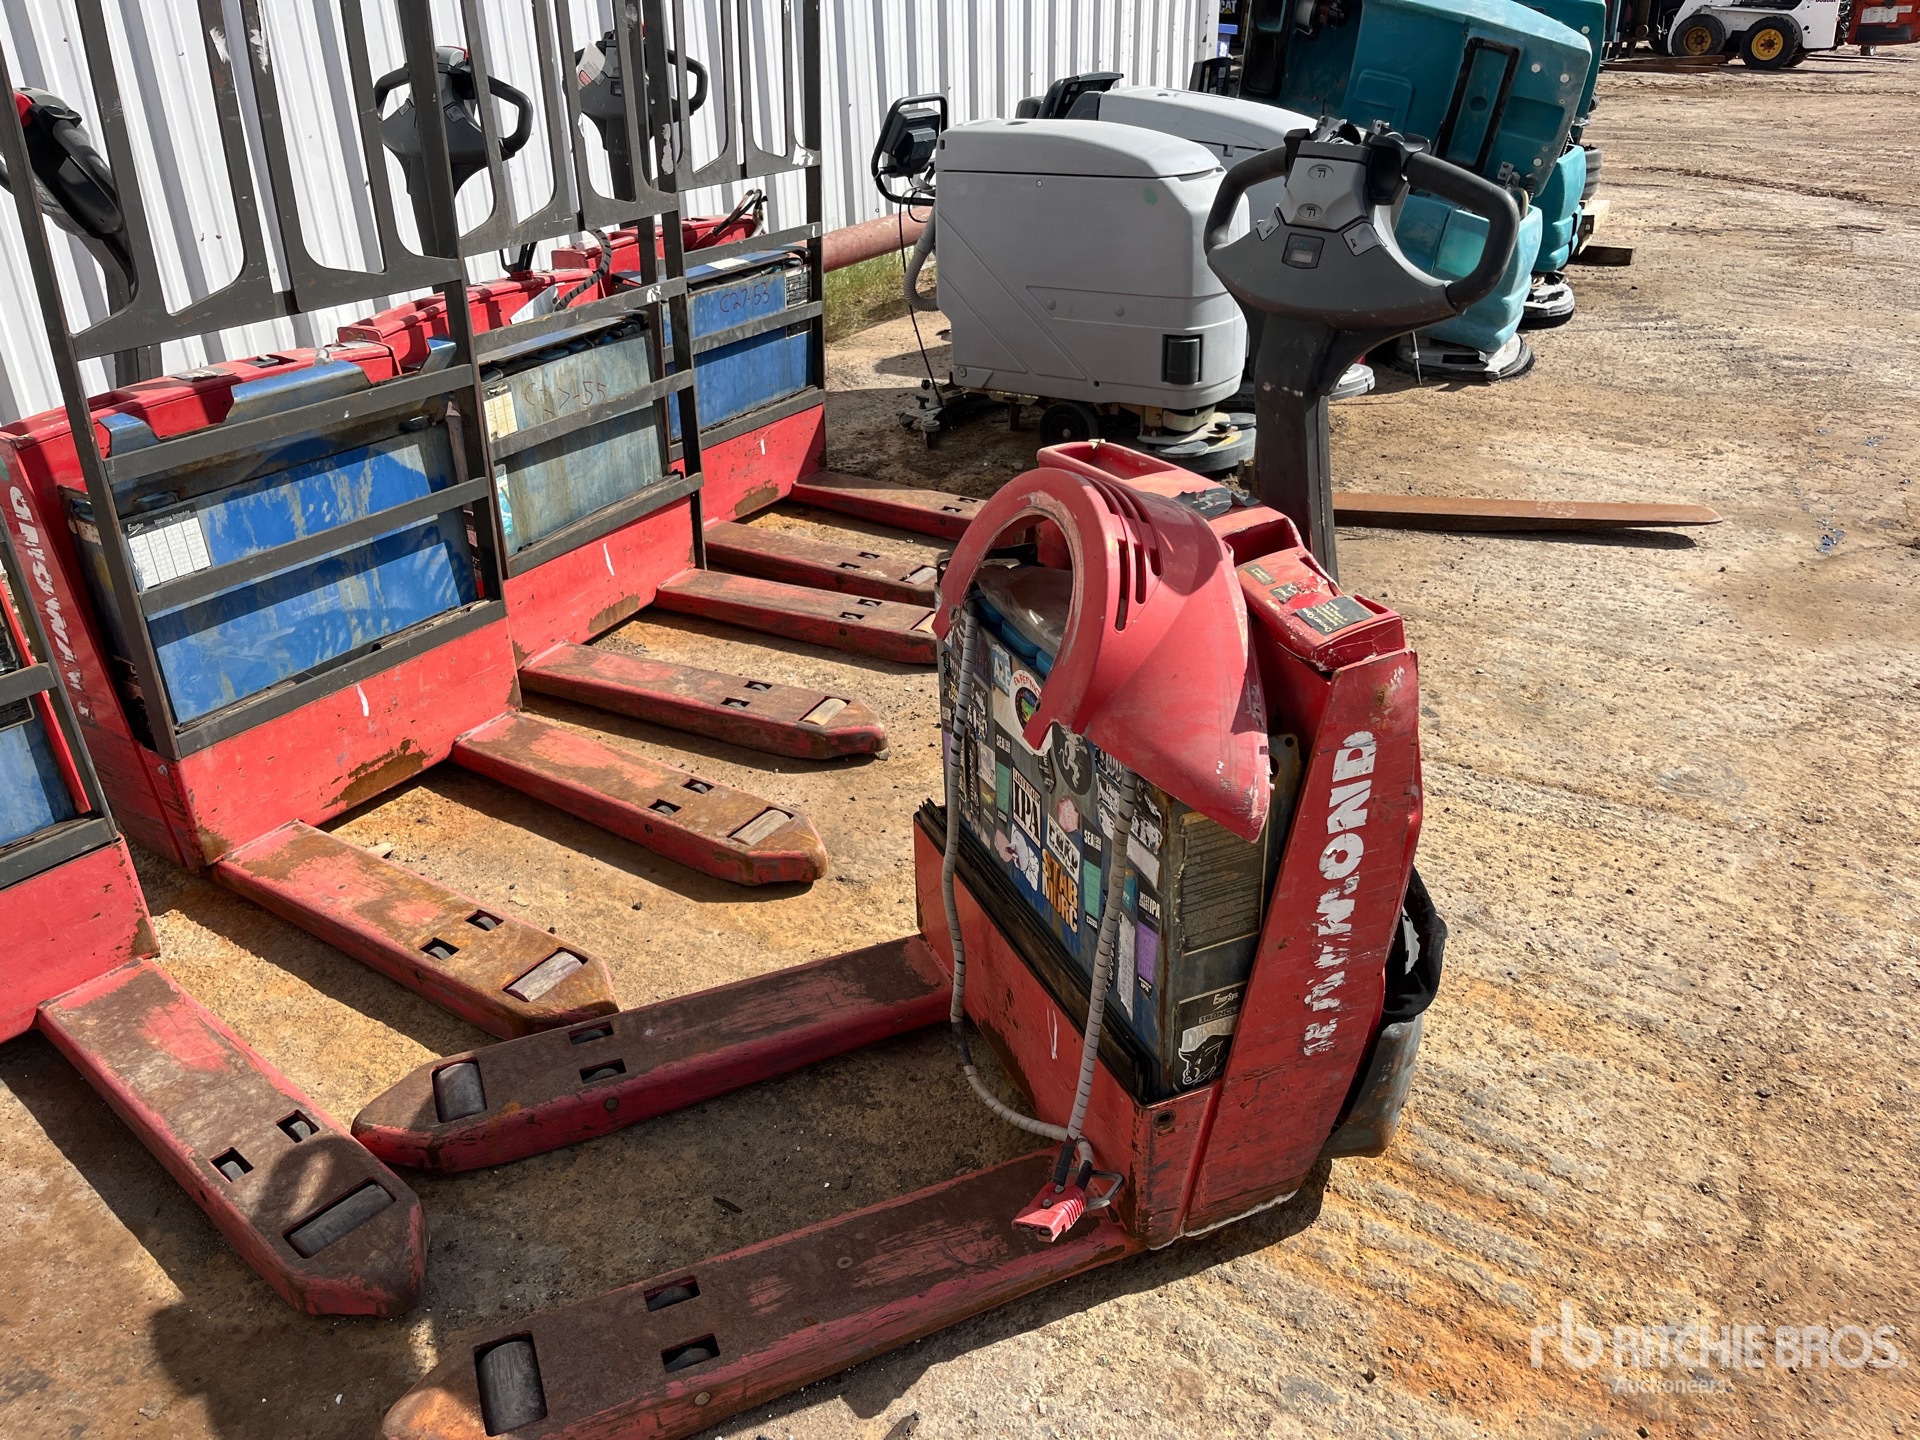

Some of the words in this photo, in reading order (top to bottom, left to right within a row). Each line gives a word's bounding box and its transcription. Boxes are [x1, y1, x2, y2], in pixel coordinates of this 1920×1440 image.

[1219, 0, 1237, 13] CAT
[720, 281, 771, 313] C27-53
[1014, 780, 1041, 841] IPA
[1150, 899, 1160, 920] IPA
[1212, 992, 1239, 1006] EnerSys
